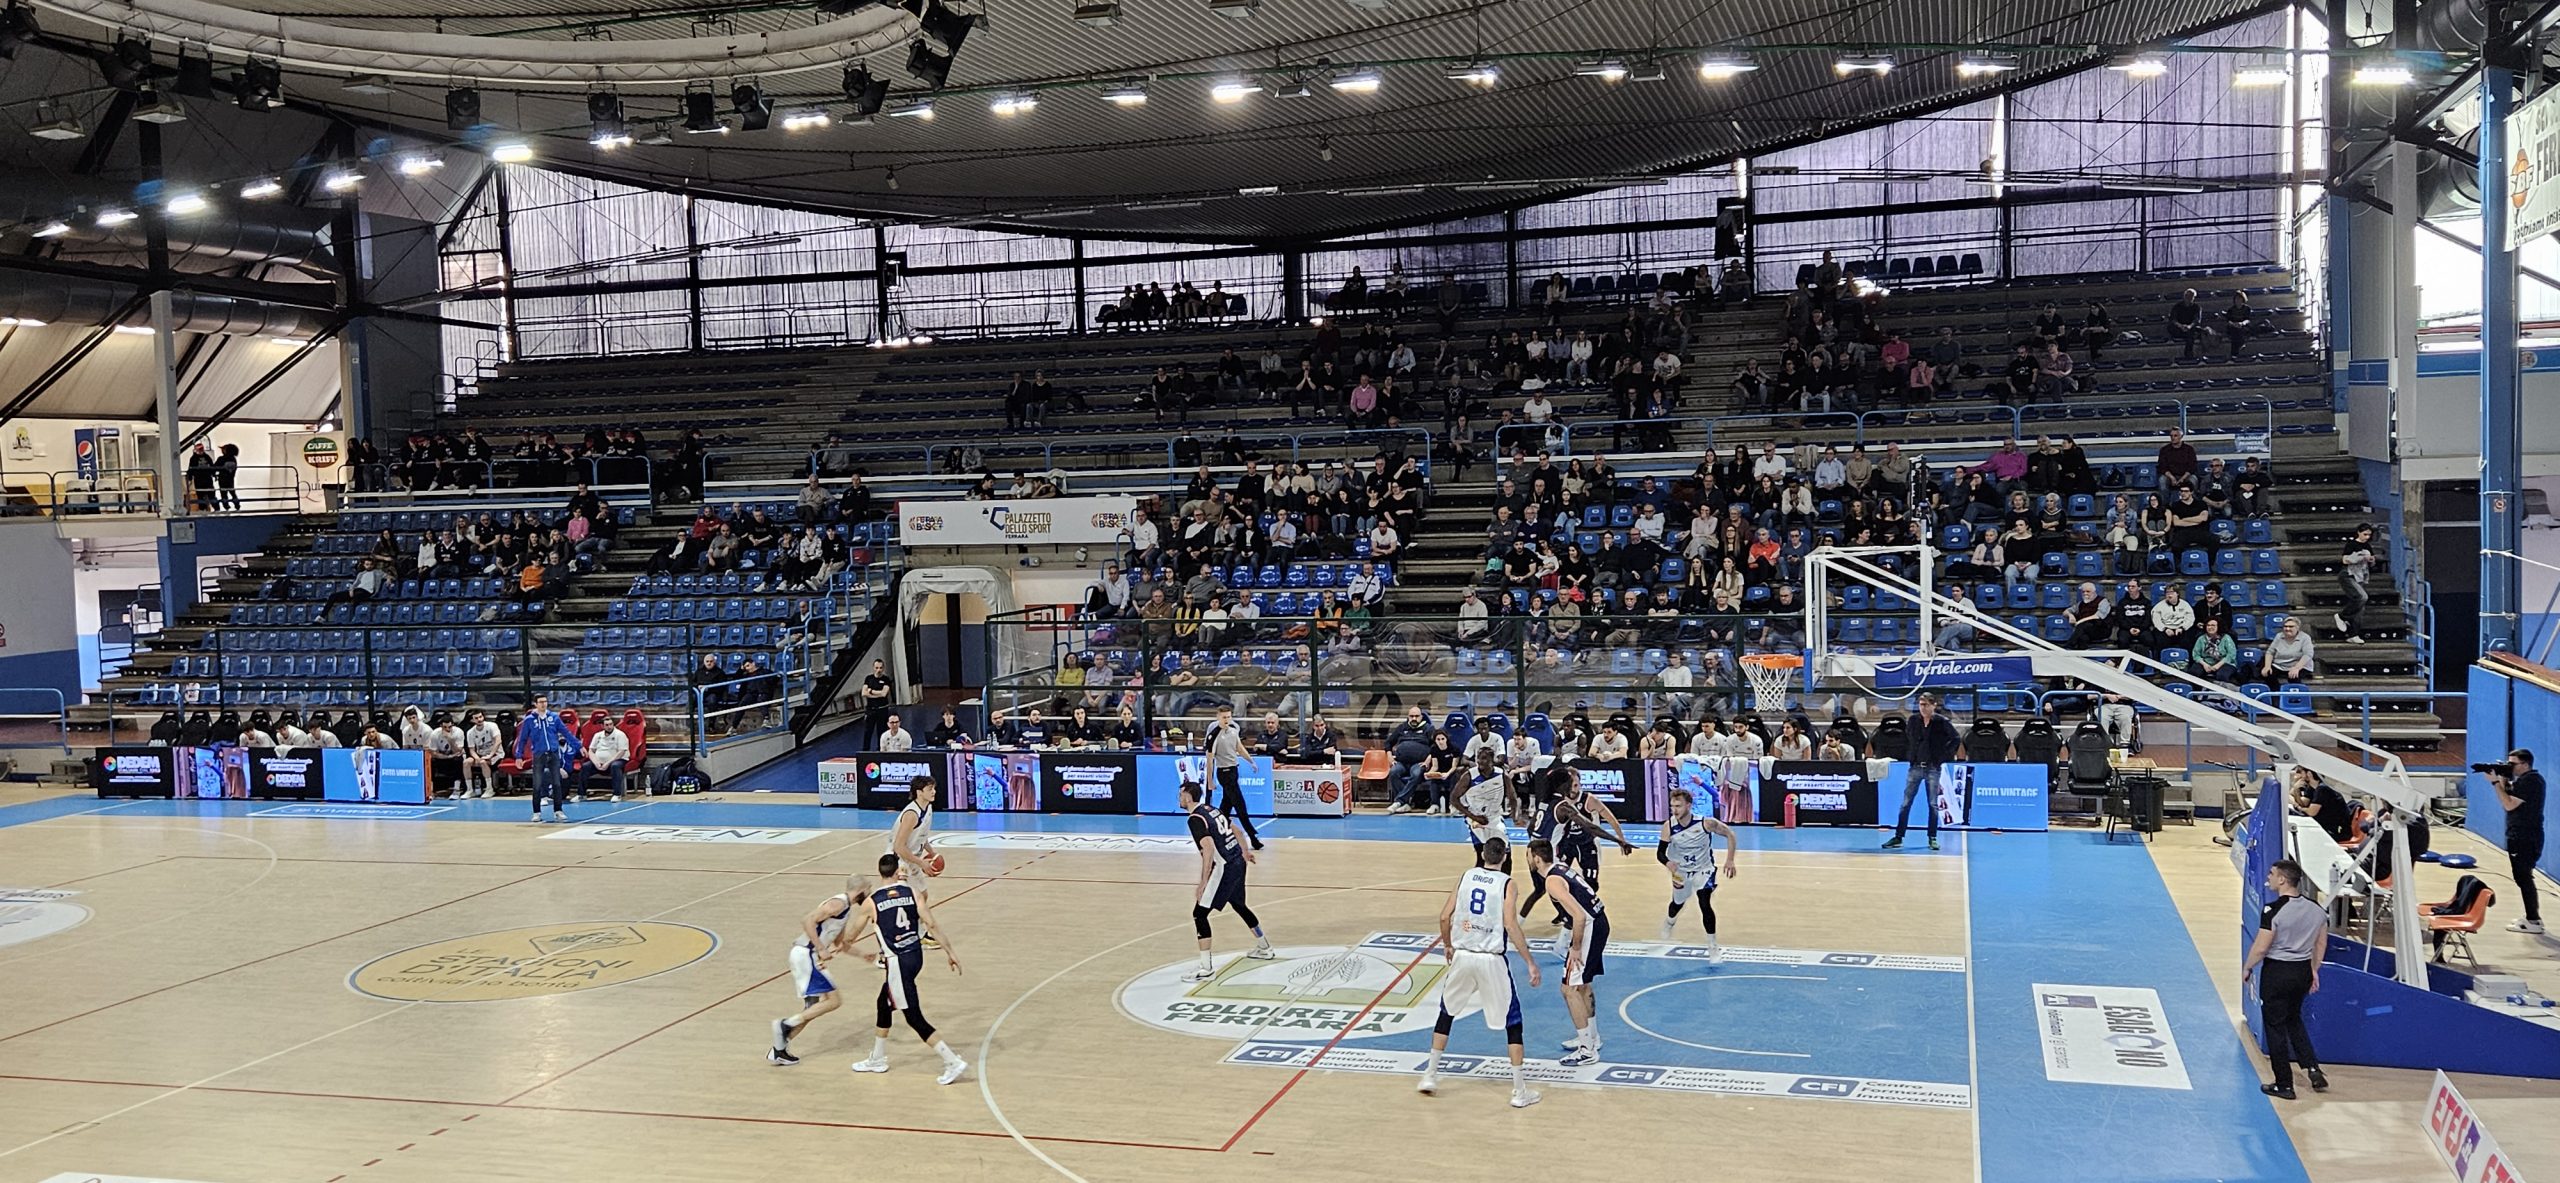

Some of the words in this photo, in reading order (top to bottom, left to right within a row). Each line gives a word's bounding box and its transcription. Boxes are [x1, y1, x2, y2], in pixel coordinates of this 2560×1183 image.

[1005, 512, 1051, 524] PALAZZETTO
[1005, 524, 1028, 534] DELLO
[1028, 523, 1051, 534] SPORT
[880, 763, 931, 777] DEDEM
[820, 772, 856, 783] LEGA
[1580, 770, 1625, 784] EDEM
[1074, 784, 1112, 794] DEDEM
[1274, 780, 1315, 791] LEGA
[1799, 793, 1847, 805] DEDEM
[1469, 888, 1486, 915] 8
[896, 907, 911, 930] 4
[430, 955, 634, 969] STAGIONI
[400, 963, 599, 980] D'ITALIA
[1167, 1002, 1407, 1023] COLDIRETTI
[1162, 1012, 1384, 1033] FERRARA
[1250, 1048, 1293, 1059] CFI
[1610, 1070, 1655, 1080] CFI
[1672, 1069, 1727, 1077] Centro
[1666, 1075, 1766, 1085] Formazione
[1866, 1081, 1923, 1089] Centro
[1660, 1081, 1766, 1092] Innovazione
[1801, 1081, 1848, 1093] CFI
[1856, 1093, 1969, 1105] Innovazione
[1861, 1087, 1968, 1099] Formazione
